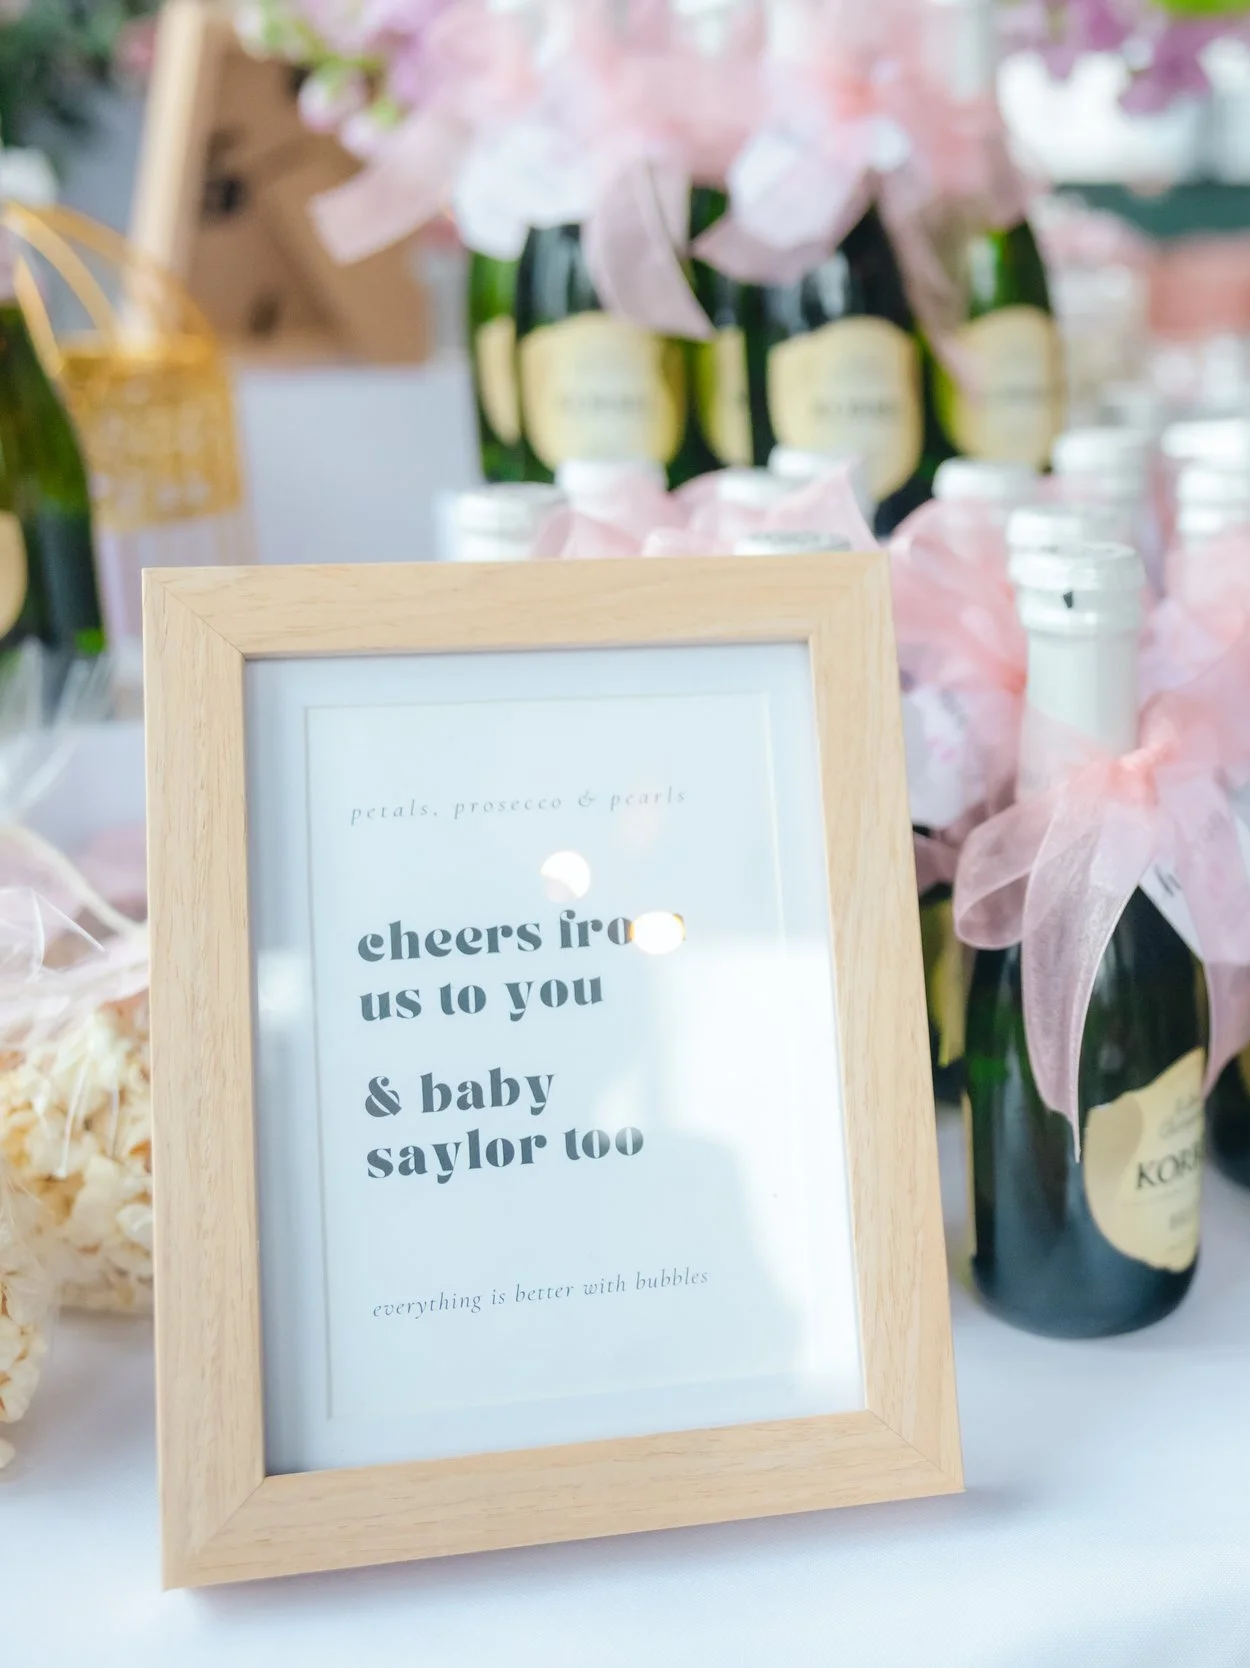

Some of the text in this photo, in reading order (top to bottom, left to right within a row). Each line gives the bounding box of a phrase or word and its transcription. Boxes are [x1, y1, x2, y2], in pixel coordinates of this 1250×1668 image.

[453, 797, 562, 821] prosecco
[577, 789, 597, 808] &
[609, 784, 687, 812] pearls
[358, 908, 686, 963] cheers fro
[360, 975, 604, 1023] us to you
[364, 1066, 556, 1118] & baby
[366, 1126, 645, 1185] saylor too
[372, 1266, 709, 1319] everything is better with bubbles
